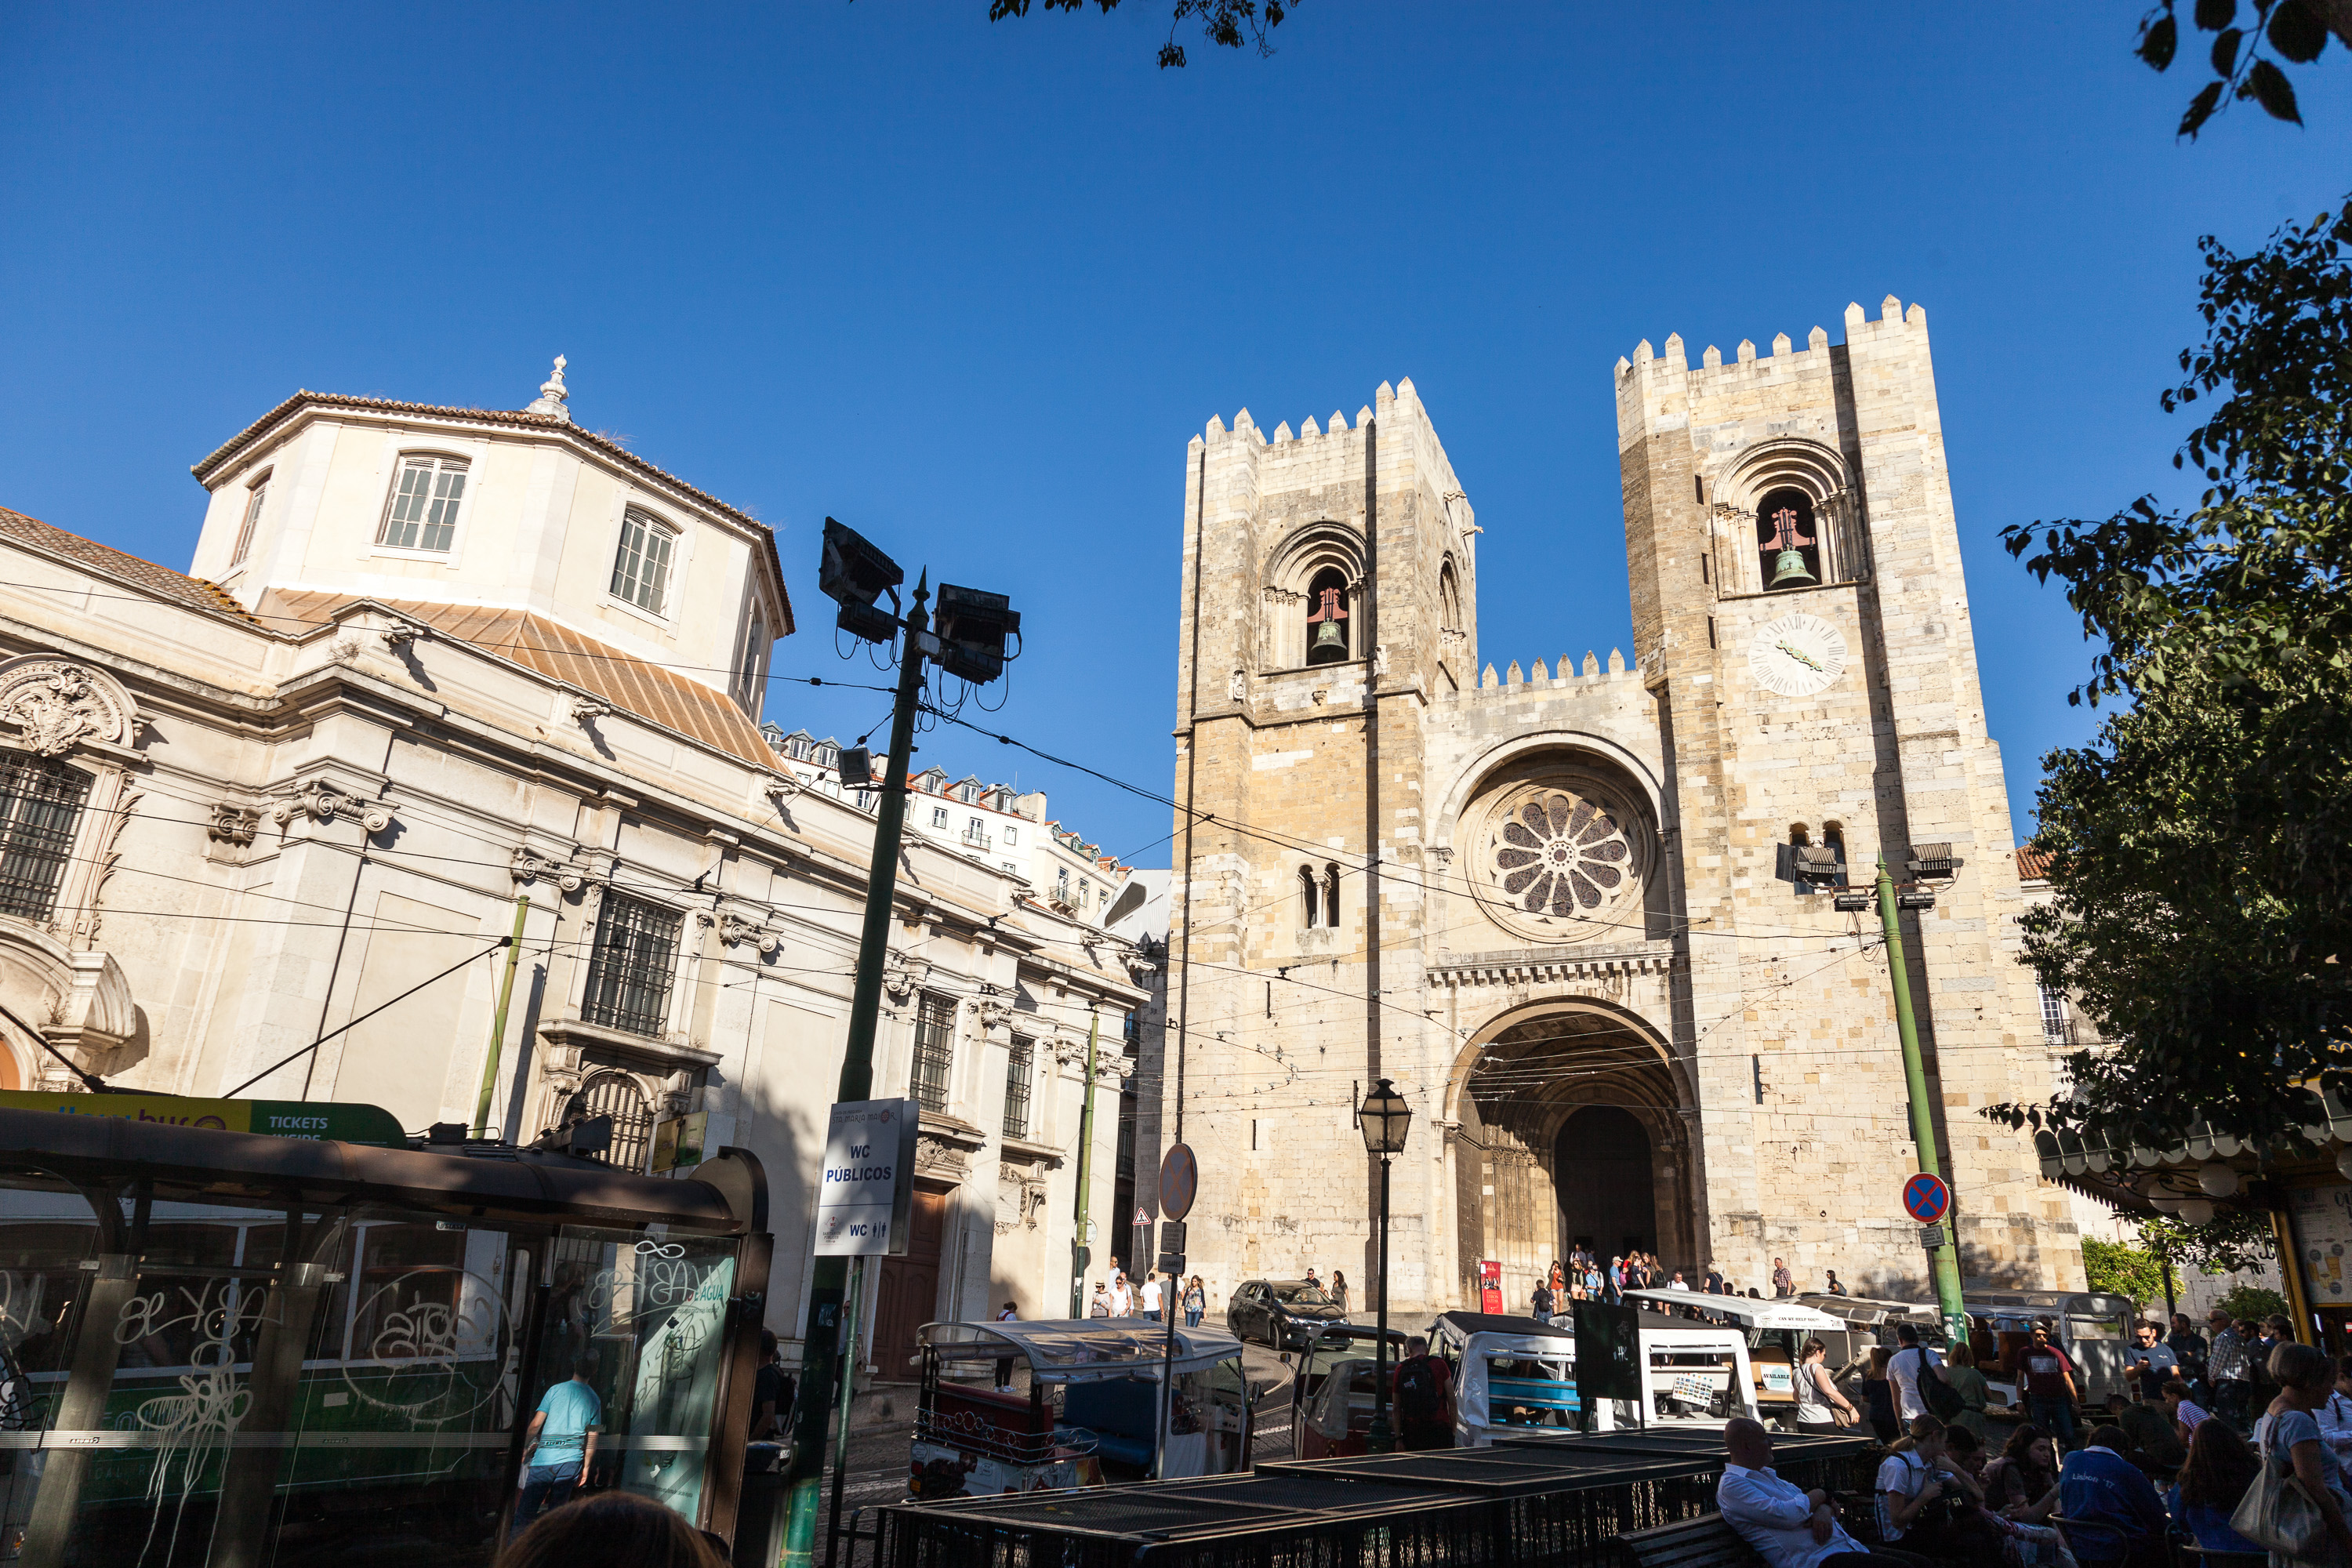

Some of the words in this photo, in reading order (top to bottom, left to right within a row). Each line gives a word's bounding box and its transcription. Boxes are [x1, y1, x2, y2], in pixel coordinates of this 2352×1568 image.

[269, 1116, 328, 1129] TICKETS
[845, 1113, 865, 1123] MARIA
[850, 1145, 870, 1159] WC
[826, 1166, 891, 1183] PÚBLICOS
[850, 1224, 867, 1236] WC
[700, 1281, 723, 1301] ÁGUA
[2072, 1471, 2099, 1483] Lisbon
